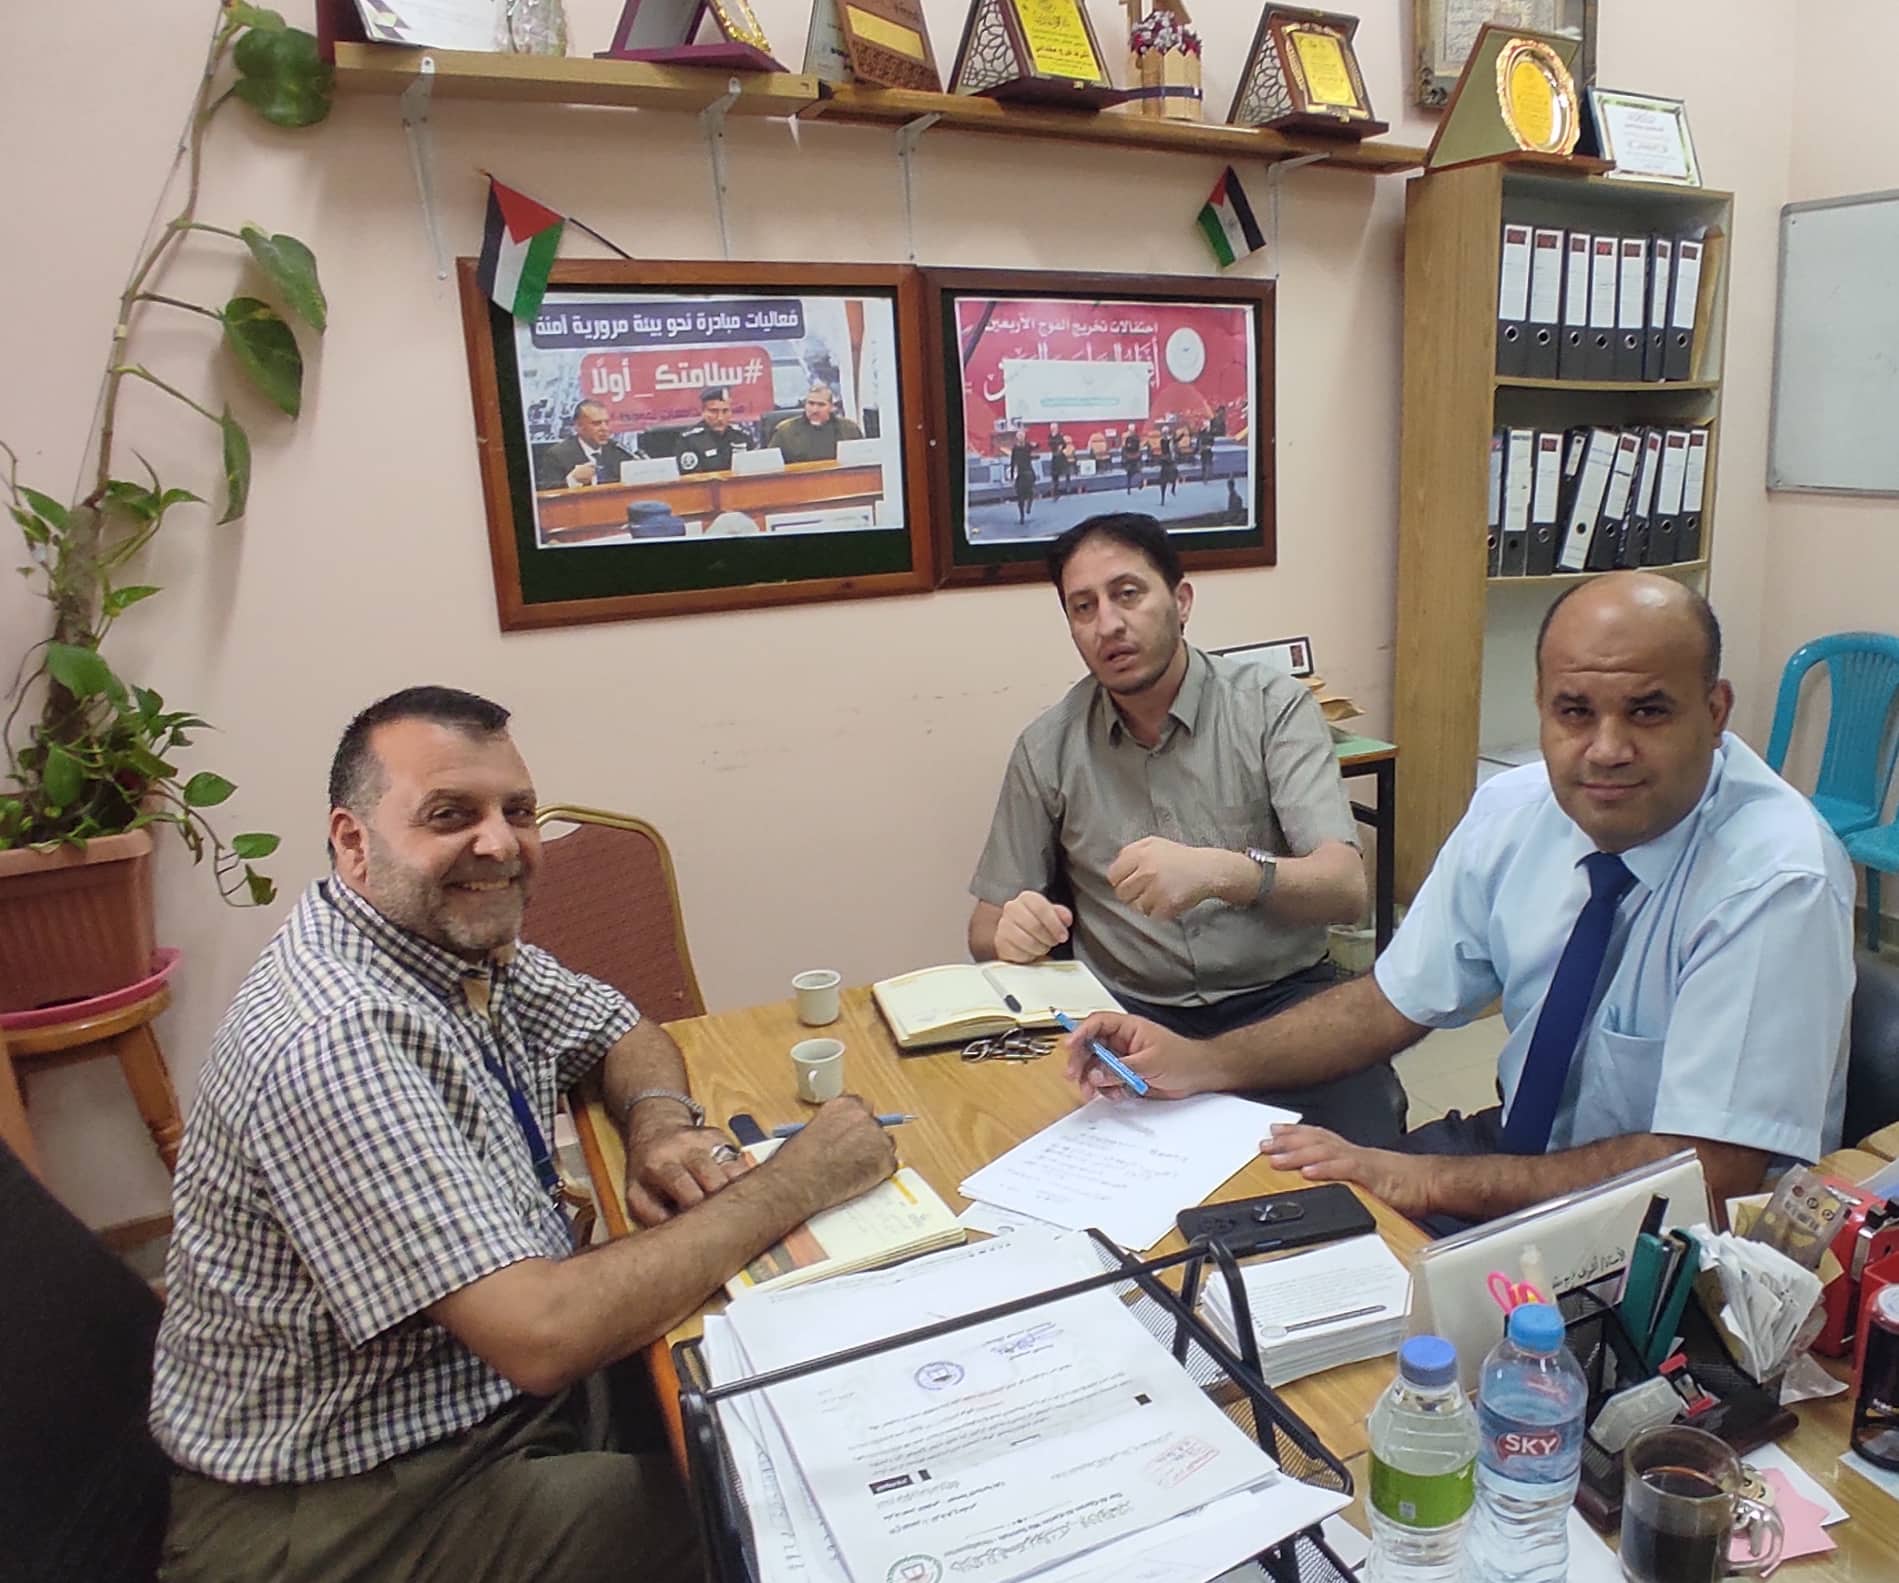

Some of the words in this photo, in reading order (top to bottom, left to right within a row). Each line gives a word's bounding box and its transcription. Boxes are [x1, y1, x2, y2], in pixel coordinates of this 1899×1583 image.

[572, 314, 629, 340] مرورية
[666, 312, 692, 337] نحو
[696, 313, 741, 336] مبادرة
[745, 310, 799, 332] فعاليات
[1505, 1433, 1557, 1455] SKY
